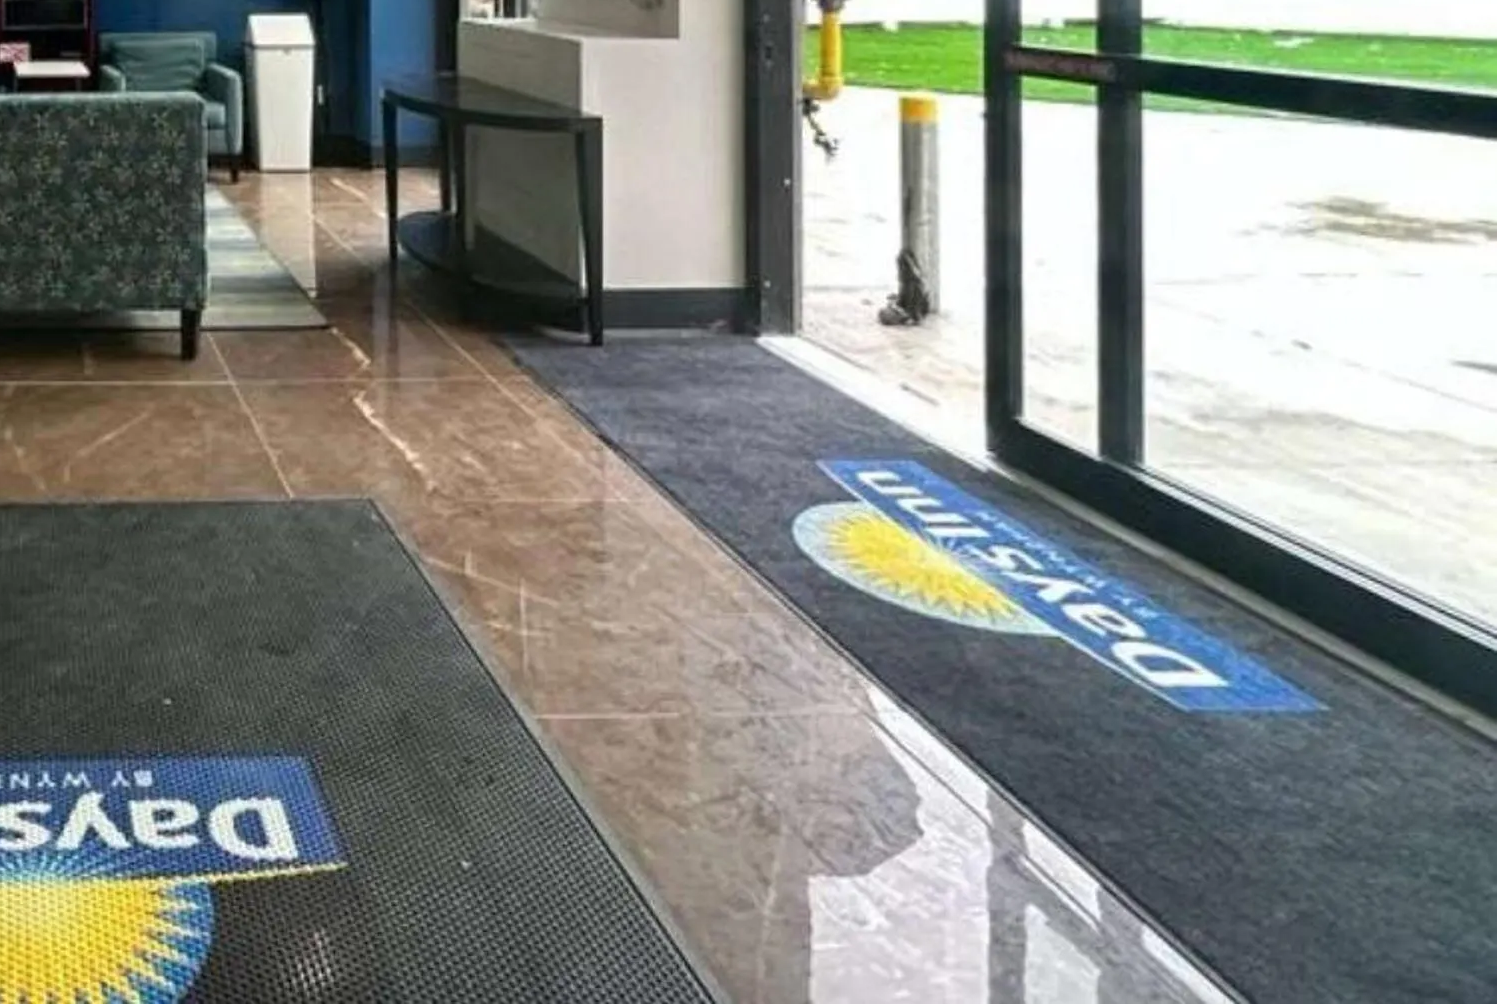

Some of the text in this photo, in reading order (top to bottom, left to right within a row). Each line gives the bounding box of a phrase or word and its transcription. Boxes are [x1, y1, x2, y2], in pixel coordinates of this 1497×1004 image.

[856, 470, 1231, 687] Days Inn
[110, 770, 153, 788] BY
